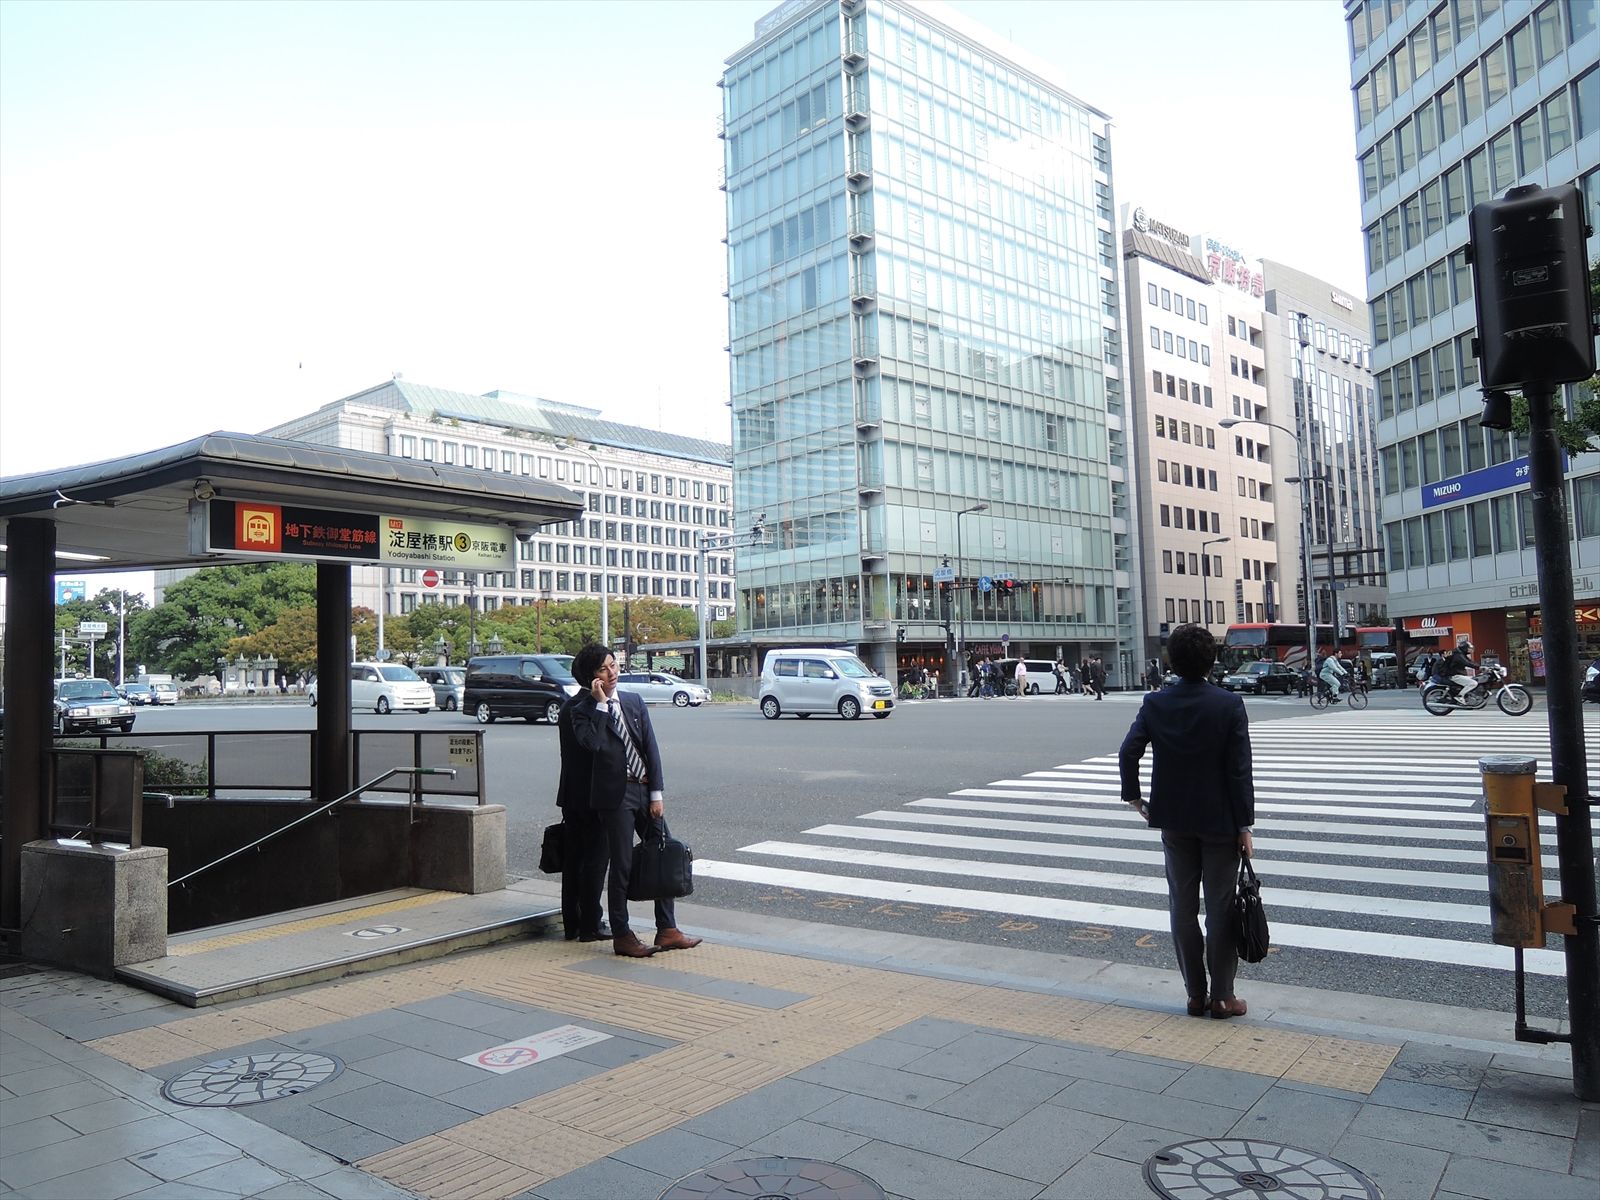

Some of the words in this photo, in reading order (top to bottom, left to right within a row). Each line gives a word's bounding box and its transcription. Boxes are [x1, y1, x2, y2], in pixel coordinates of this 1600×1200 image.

[1207, 253, 1264, 299] 京阪特急
[1433, 482, 1462, 498] MIZUHO
[285, 523, 377, 544] 地下鉄御堂筋線
[389, 530, 453, 552] 淀屋橋駅
[459, 535, 467, 550] 3
[472, 540, 508, 553] 京阪電車
[387, 550, 431, 560] Yodoyabashi
[432, 553, 456, 562] Station
[1421, 617, 1438, 628] au
